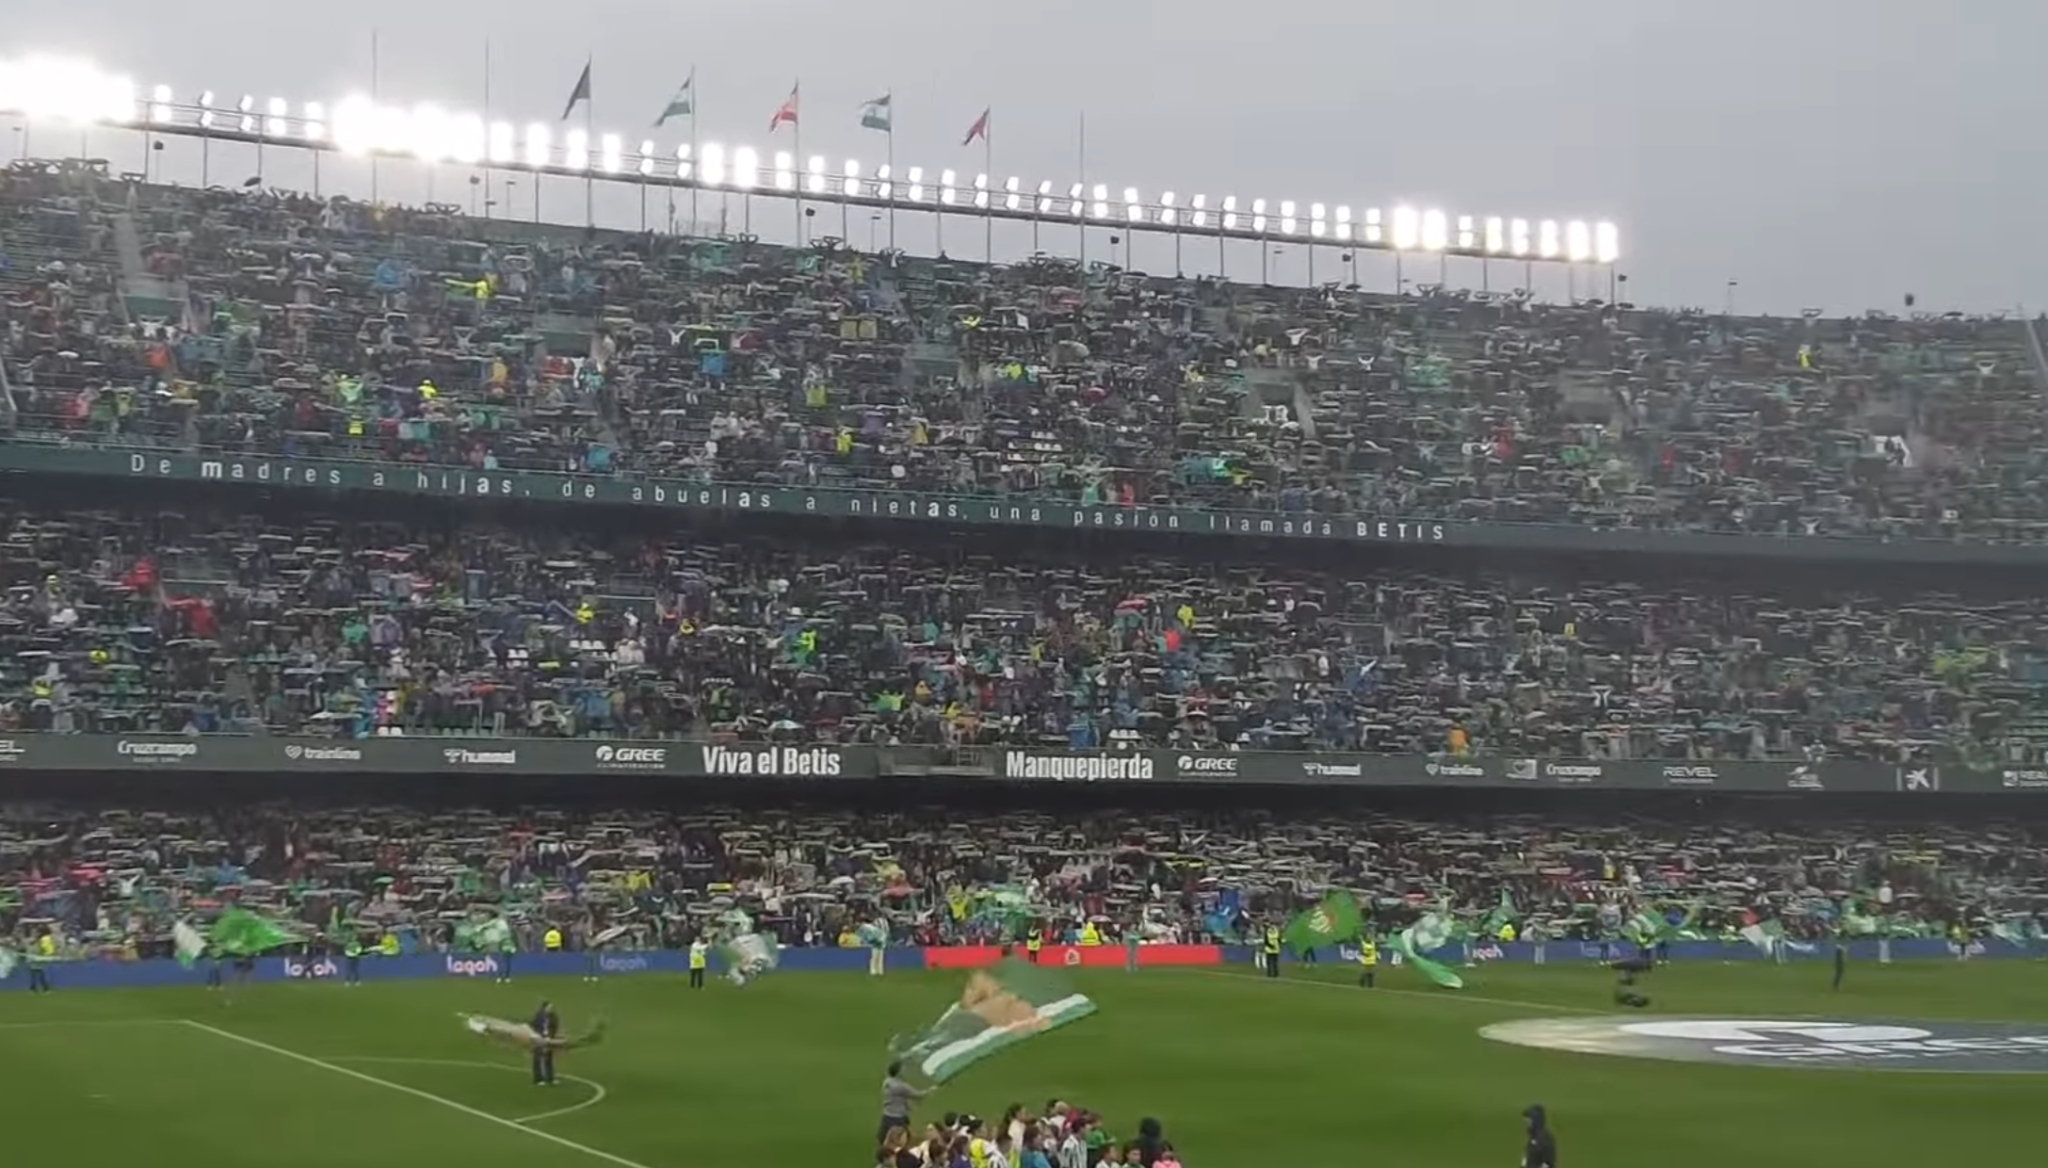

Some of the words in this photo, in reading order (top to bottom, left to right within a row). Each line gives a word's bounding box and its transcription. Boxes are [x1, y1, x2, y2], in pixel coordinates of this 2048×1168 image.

[131, 454, 171, 474] De
[202, 460, 341, 484] madres
[373, 472, 385, 487] a
[562, 482, 596, 498] de
[632, 486, 771, 508] abuelas
[805, 497, 816, 510] a
[990, 507, 1041, 521] una
[1210, 514, 1332, 535] llamada
[1357, 521, 1444, 540] BETIS
[615, 748, 666, 761] GREE
[703, 745, 751, 774] Viva
[757, 746, 777, 774] el
[783, 747, 840, 776] Betis
[1006, 751, 1153, 781] Manquepierda
[1195, 757, 1238, 770] GREE
